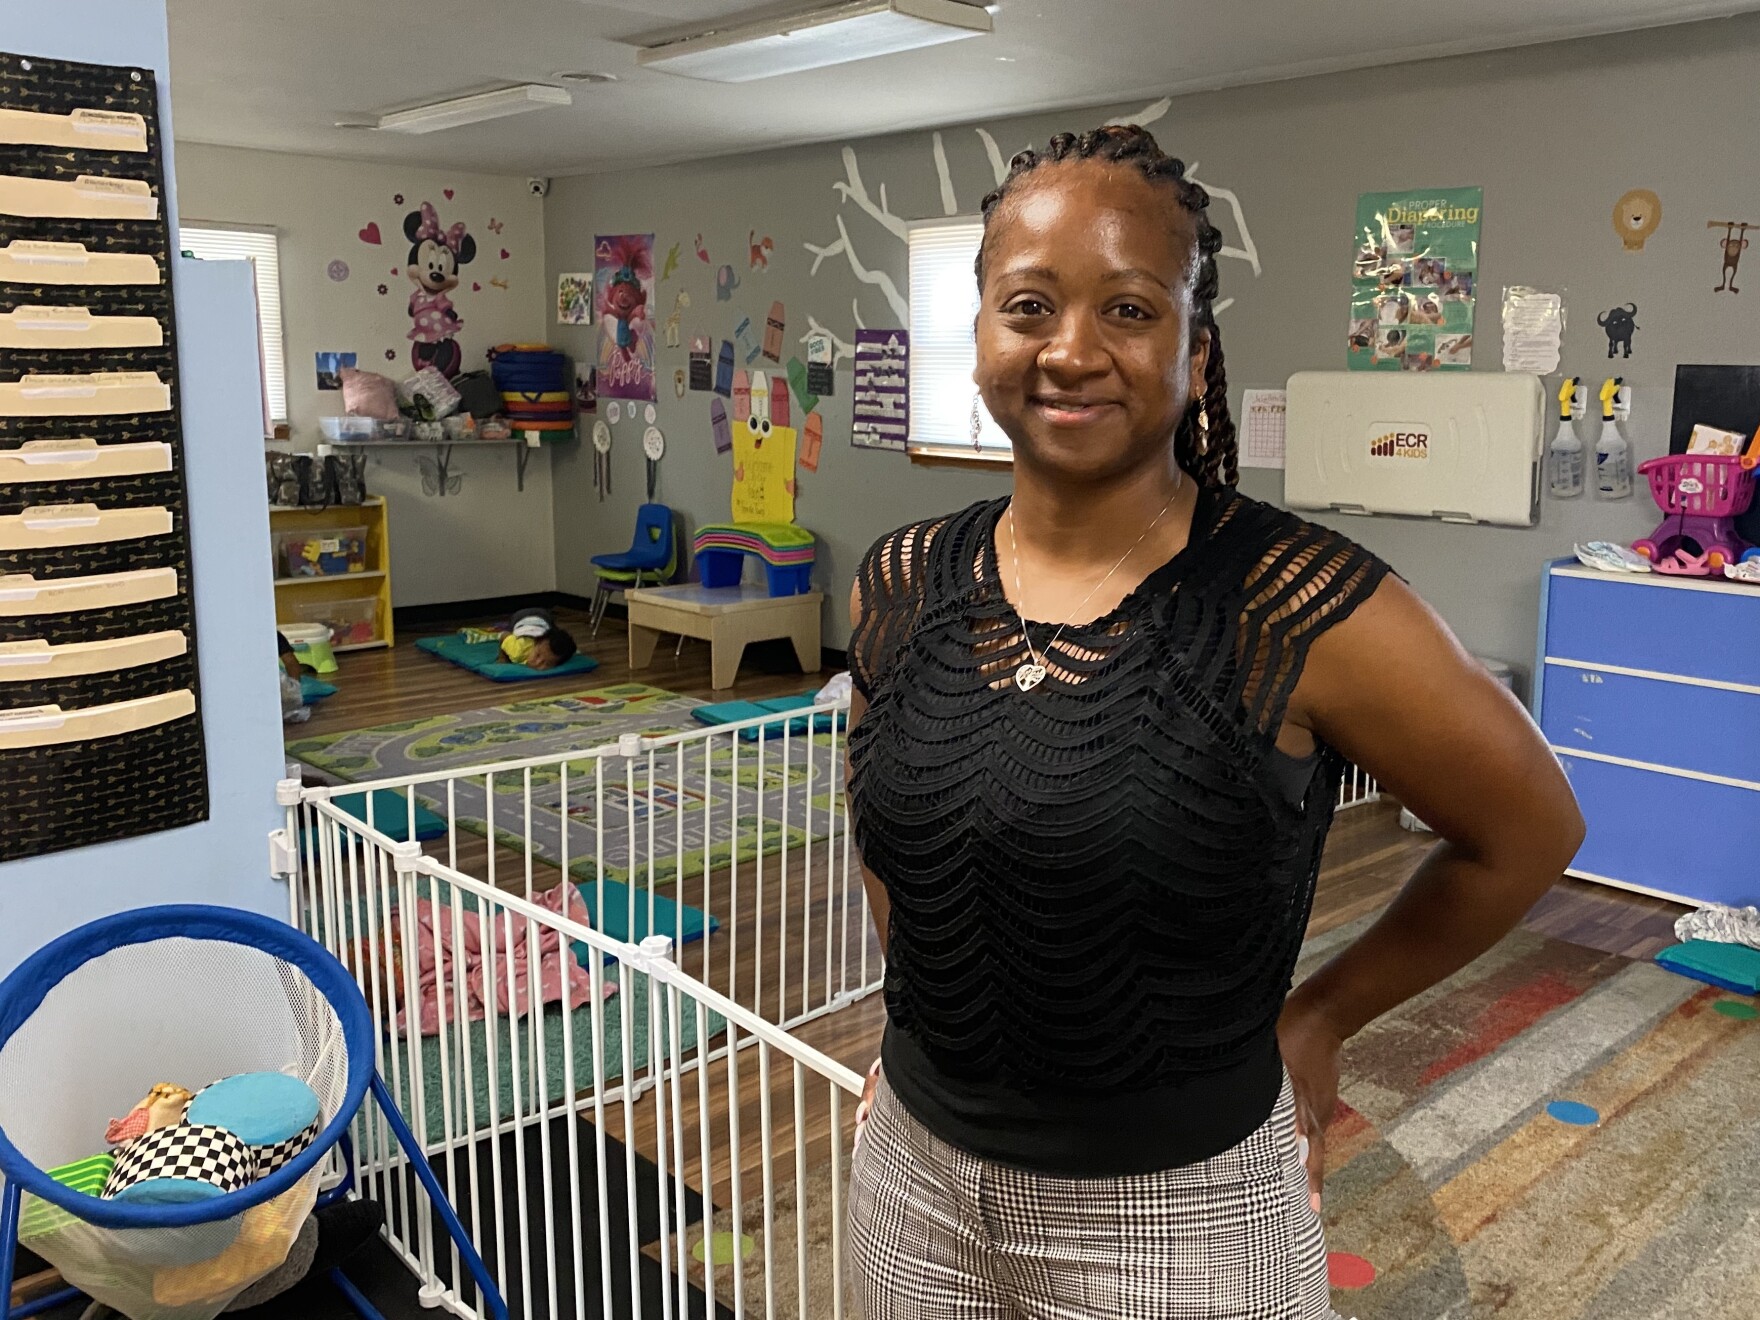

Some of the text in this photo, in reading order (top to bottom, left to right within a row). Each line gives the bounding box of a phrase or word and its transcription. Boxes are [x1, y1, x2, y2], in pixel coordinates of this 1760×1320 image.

[1408, 199, 1447, 210] PROPER
[1388, 205, 1479, 225] Diapering
[608, 349, 643, 387] Poppy
[1396, 433, 1428, 448] ECR
[1396, 448, 1428, 458] 4 KIDS
